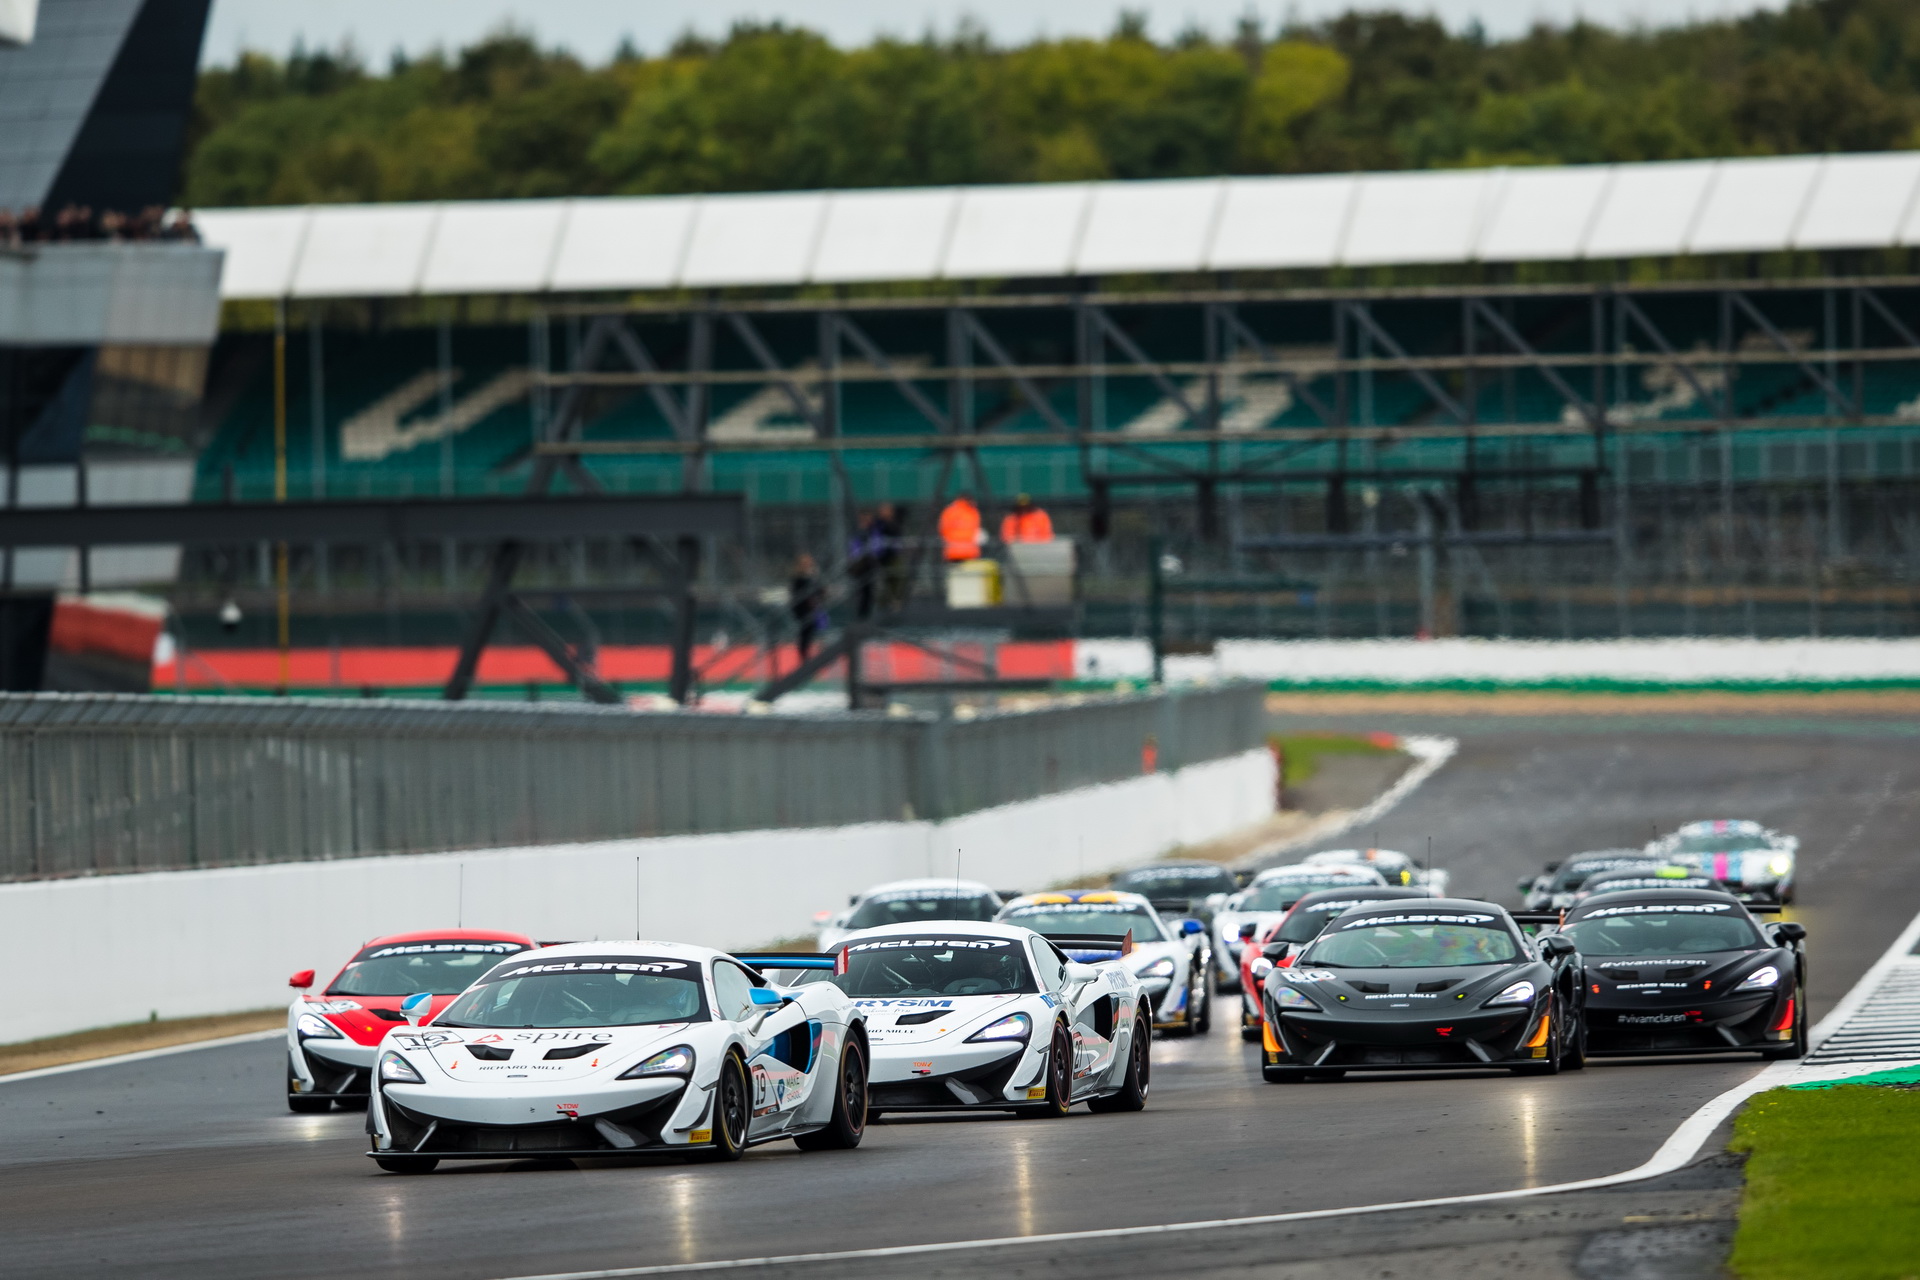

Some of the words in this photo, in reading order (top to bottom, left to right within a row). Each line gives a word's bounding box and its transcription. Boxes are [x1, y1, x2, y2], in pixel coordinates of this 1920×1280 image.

[1365, 992, 1407, 1000] RICHARD
[854, 999, 954, 1008] RYSM
[1617, 1012, 1687, 1024] #vivamclaren
[404, 1034, 449, 1047] 19
[512, 1030, 613, 1044] spire
[755, 1072, 766, 1106] 19
